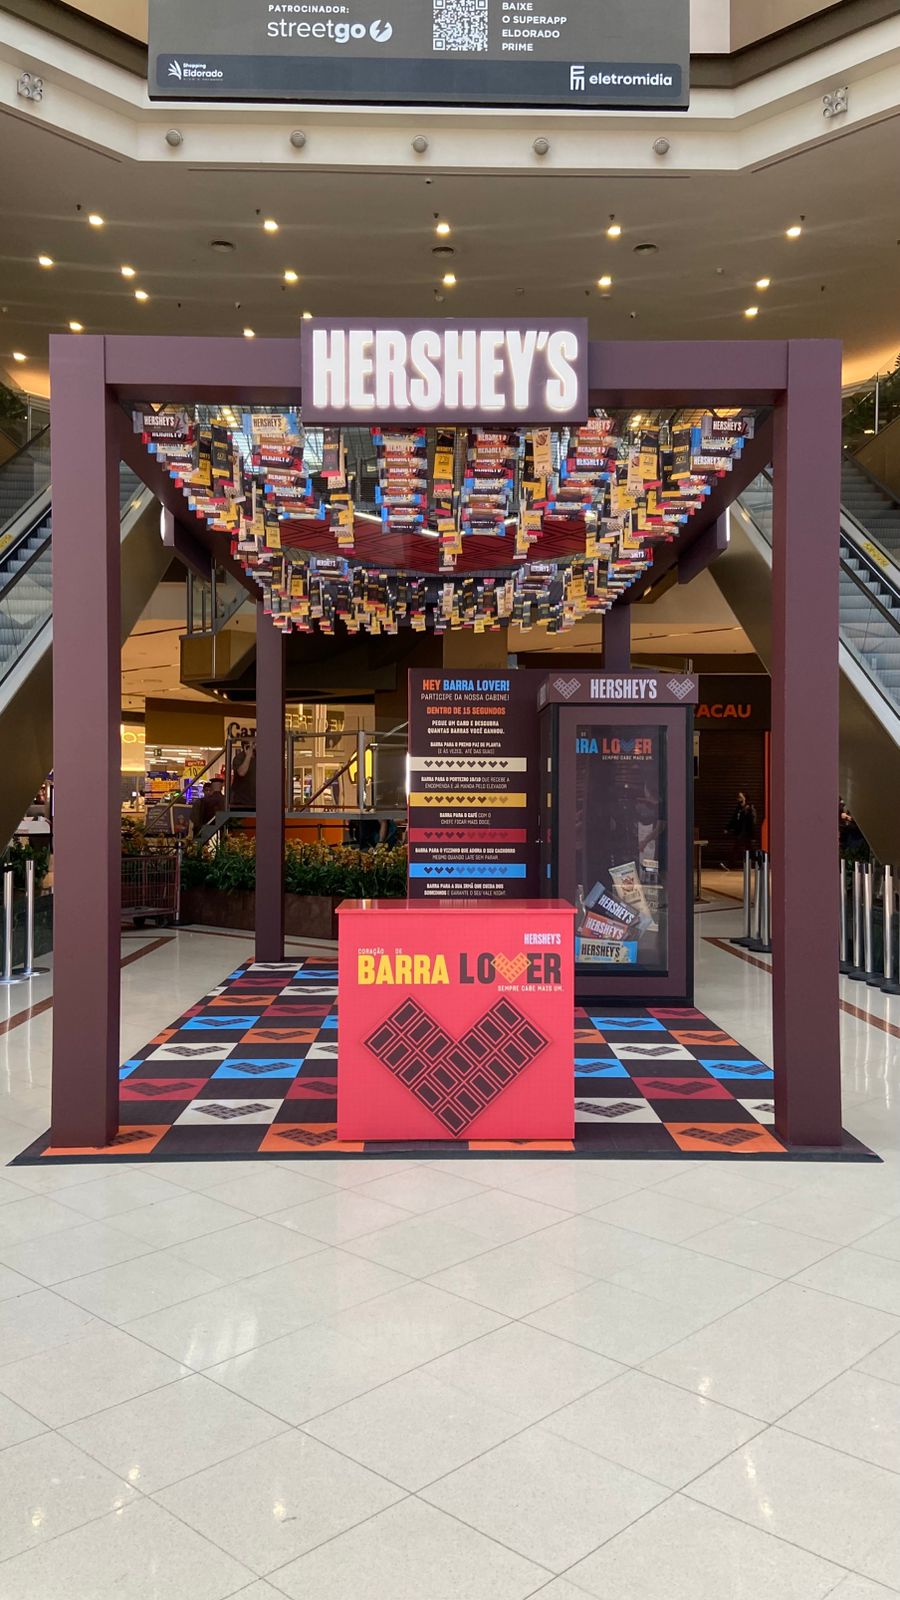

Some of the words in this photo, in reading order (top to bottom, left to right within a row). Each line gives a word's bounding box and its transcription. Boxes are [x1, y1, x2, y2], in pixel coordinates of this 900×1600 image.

[268, 4, 350, 14] PATROCINADOR:
[502, 2, 533, 11] BAIXE
[502, 16, 510, 24] O
[513, 16, 568, 25] SUPERAPP
[267, 18, 366, 43] streetgo
[502, 30, 560, 38] ELDORADO
[502, 42, 534, 52] PRIME
[183, 68, 224, 78] Eldorado
[589, 72, 672, 86] eletromidia
[313, 329, 578, 410] HERSHEY'S
[422, 680, 441, 691] HEY
[443, 680, 474, 691] BARRA
[476, 680, 510, 691] LOVER!
[590, 679, 658, 699] HERSHEY'S
[426, 707, 452, 715] DENTRO
[453, 707, 461, 715] DE
[463, 707, 470, 715] 15
[472, 707, 506, 715] SEGUNDOS
[694, 704, 751, 718] ACAU
[598, 894, 634, 924] HERSHEY'S
[586, 918, 624, 940] HERSHEY'S
[524, 933, 562, 945] HERSHEY'S
[581, 944, 620, 958] HERSHEY'S
[358, 954, 450, 984] BARRA
